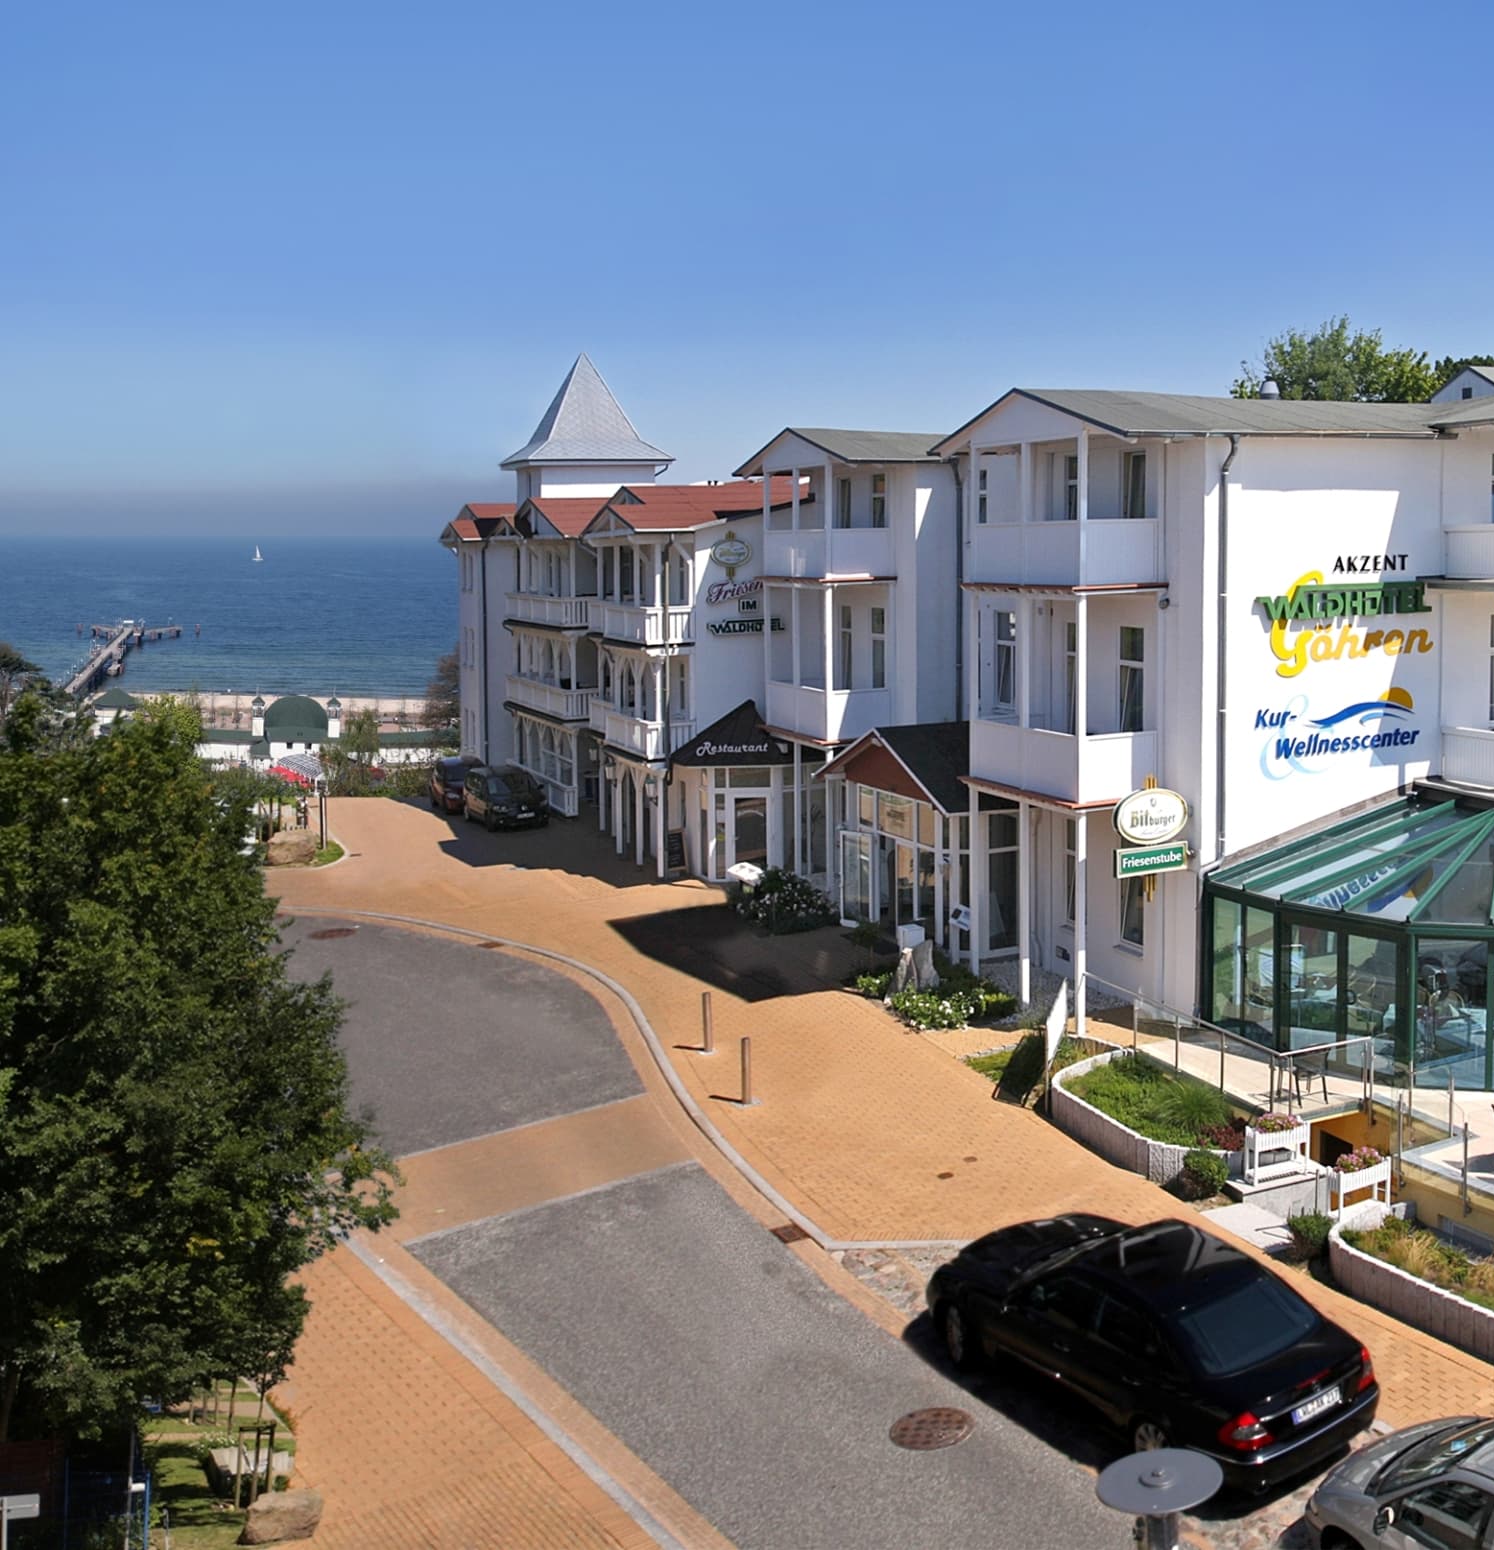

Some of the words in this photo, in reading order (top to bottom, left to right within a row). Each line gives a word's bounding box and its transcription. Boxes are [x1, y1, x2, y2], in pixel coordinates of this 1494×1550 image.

[1333, 554, 1409, 573] AKZENT
[742, 600, 757, 610] IM
[1254, 581, 1432, 620] WALDHOTEL
[709, 618, 785, 634] WALDHOEL
[1254, 709, 1297, 730] Kur-
[696, 741, 769, 756] Restaurant
[1275, 728, 1420, 760] Wellnesscenter
[1129, 809, 1176, 829] Bitburger
[1122, 851, 1182, 869] Friesenstube
